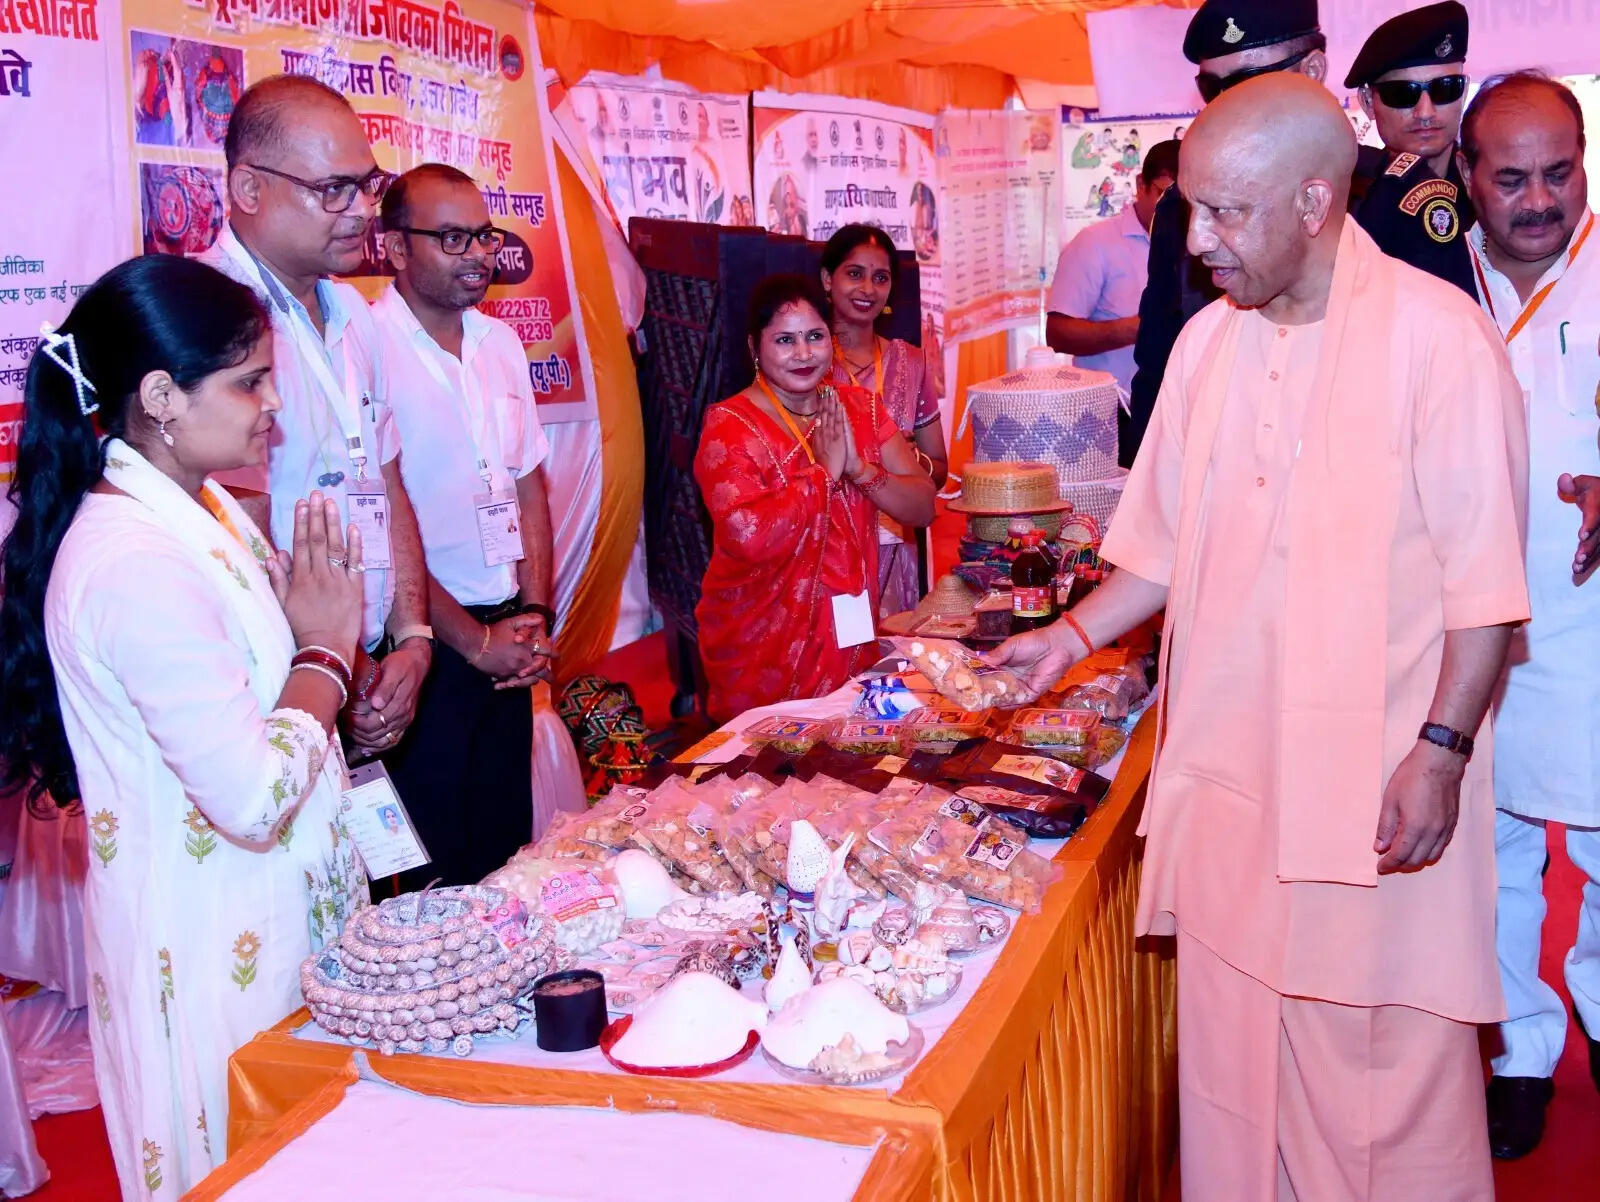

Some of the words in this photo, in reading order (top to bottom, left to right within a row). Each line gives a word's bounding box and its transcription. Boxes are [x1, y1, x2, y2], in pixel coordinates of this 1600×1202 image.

[443, 1, 493, 72] मिशन
[478, 138, 512, 180] समूह
[1406, 183, 1455, 210] COMMANDO
[510, 195, 544, 225] समूह
[496, 246, 525, 271] त्पाद
[24, 287, 46, 305] एक
[50, 280, 67, 303] नई
[477, 299, 550, 319] 20222672
[514, 322, 553, 342] 8239
[1, 334, 40, 359] संकुल
[0, 365, 26, 390] संकु
